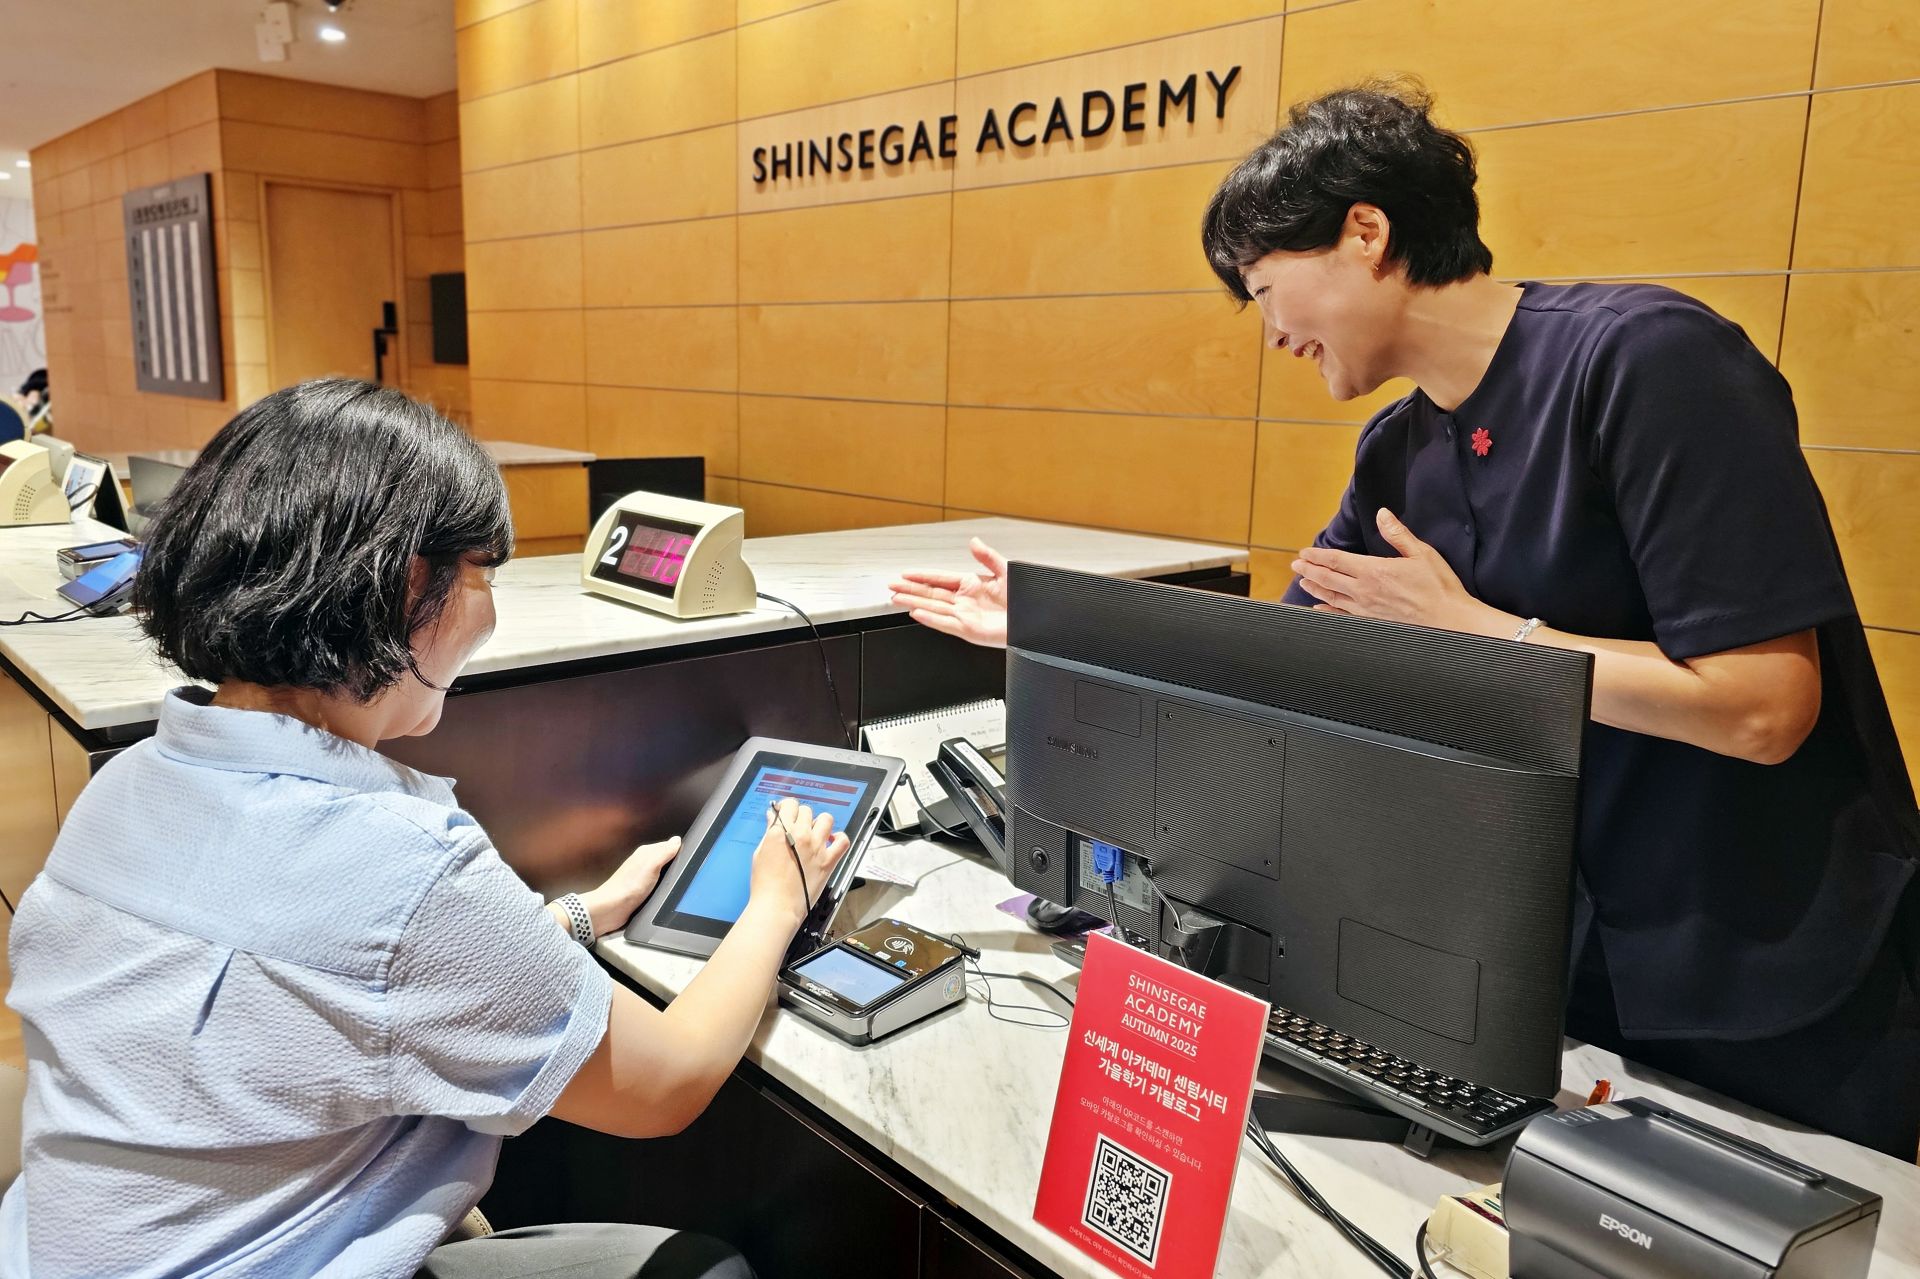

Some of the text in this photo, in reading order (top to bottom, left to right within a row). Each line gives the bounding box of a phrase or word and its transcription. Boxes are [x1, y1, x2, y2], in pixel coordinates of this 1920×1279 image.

[752, 65, 1242, 184] SHINSEGAE ACADEMY
[600, 525, 629, 566] 2
[1125, 993, 1202, 1038] ACADEMY
[1128, 974, 1207, 1019] SHINSEGAE
[1121, 1013, 1198, 1057] AUTUMN 2025
[1084, 1029, 1228, 1114] 신세계 아카데미 센텀시티
[1098, 1057, 1200, 1122] 가을학기 카탈로그
[1080, 1097, 1100, 1114] 모바일
[1100, 1108, 1133, 1133] 카탈로그를
[1134, 1127, 1163, 1149] 확인하실
[1163, 1144, 1171, 1153] 수
[1102, 1096, 1183, 1147] 아래의 QR코드를 스캔하면
[1599, 1213, 1654, 1250] EPSON
